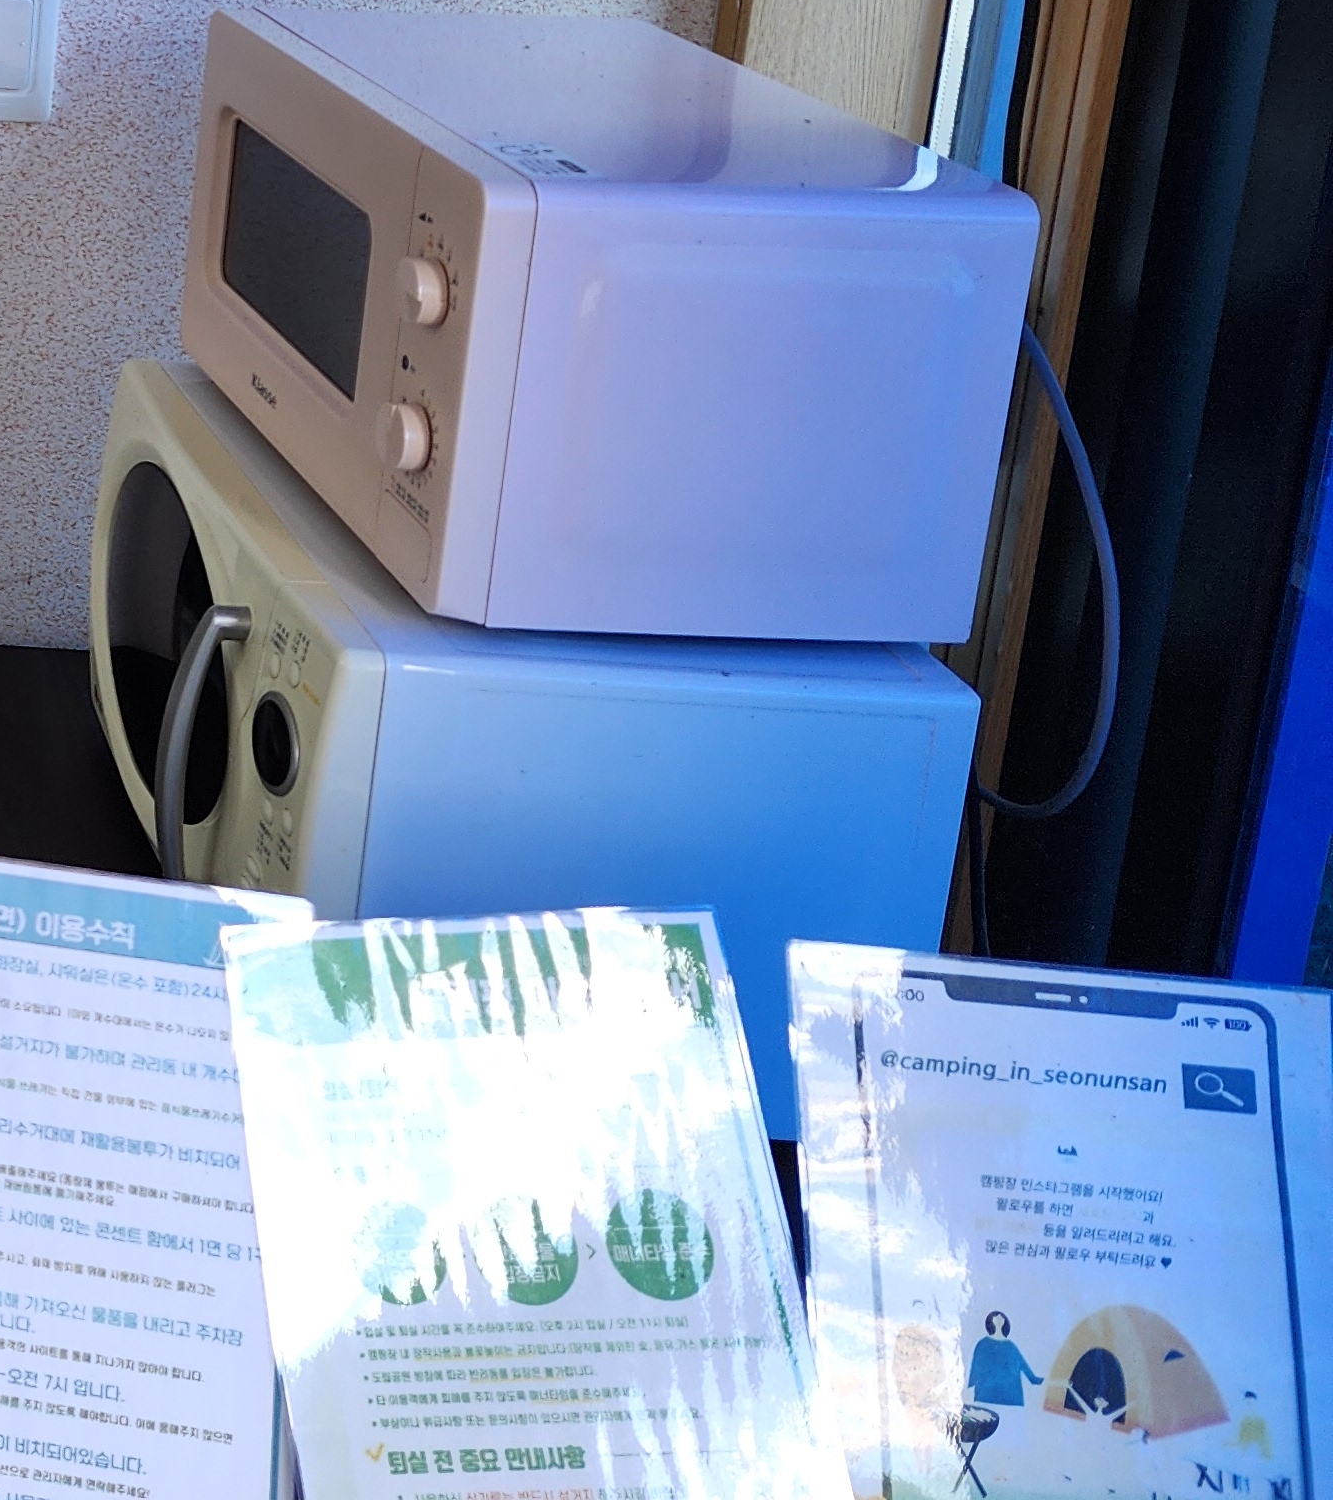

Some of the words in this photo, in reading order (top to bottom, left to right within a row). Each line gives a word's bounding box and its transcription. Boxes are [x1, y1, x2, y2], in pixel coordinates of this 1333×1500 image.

[35, 911, 135, 950] 이용수칙
[0, 1035, 59, 1058] 설거지가
[131, 1053, 177, 1075] 관리동
[182, 1062, 196, 1078] 내
[880, 1049, 1168, 1095] @camping_in_seonunsan
[178, 1147, 241, 1170] 비치되어
[1049, 1203, 1073, 1217] 하면
[9, 1208, 55, 1231] 사이에
[60, 1217, 90, 1236] 있는
[95, 1222, 143, 1244] 콘센트
[147, 1230, 194, 1254] 함에서
[25, 1295, 86, 1321] 가져오신
[144, 1315, 191, 1338] 내리고
[196, 1324, 243, 1347] 주차장
[44, 1374, 68, 1392] 7시
[74, 1379, 125, 1402] 입니다.
[14, 1437, 146, 1475] 비치되어있습니다.
[388, 1451, 428, 1475] 퇴실
[433, 1450, 454, 1473] 전
[460, 1449, 501, 1473] 중요
[505, 1446, 586, 1470] 안내사항
